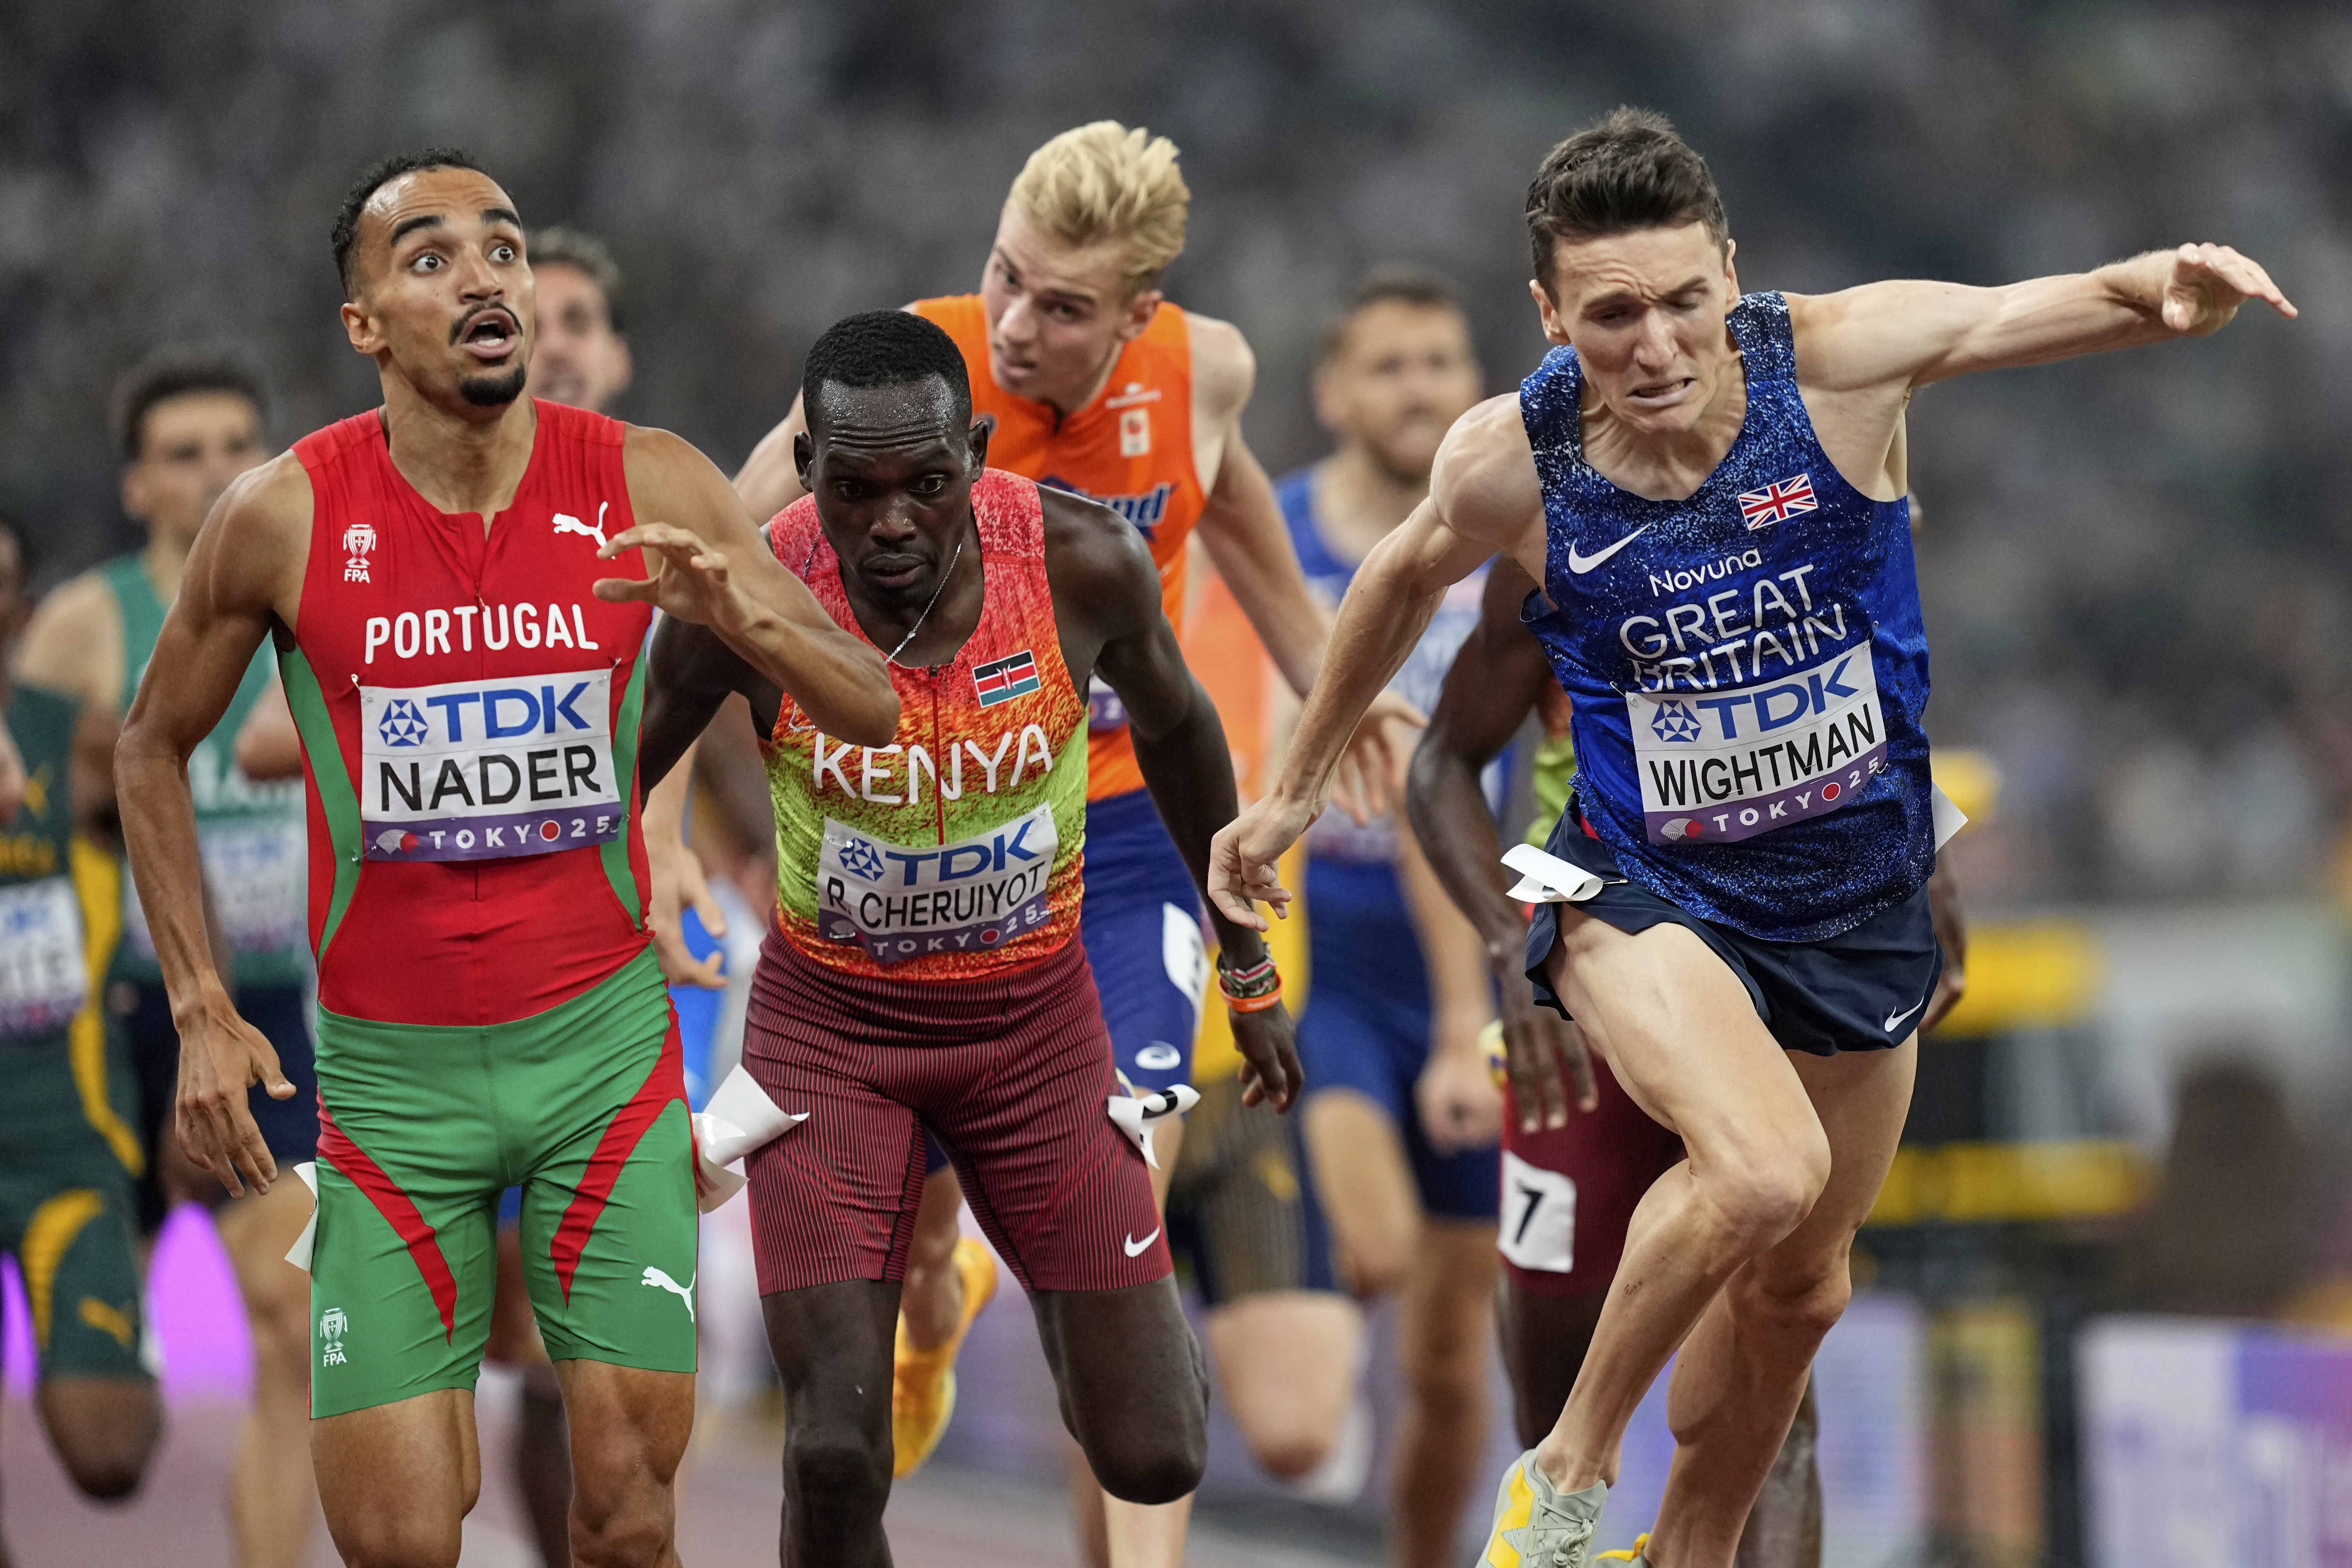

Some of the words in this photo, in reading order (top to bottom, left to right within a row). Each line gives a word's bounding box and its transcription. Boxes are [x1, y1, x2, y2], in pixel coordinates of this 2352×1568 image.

[344, 568, 370, 583] FPA
[1649, 548, 1762, 597] Novuna
[365, 603, 599, 664] PORTUGAL
[1619, 564, 1814, 658] GREAT
[1626, 603, 1847, 693] BRITAIN
[426, 682, 591, 743] TDK
[1697, 656, 1859, 740] TDK
[379, 745, 601, 811] NADER
[813, 724, 1052, 804] KENYA
[1649, 703, 1875, 806] WIGHTMAN
[885, 819, 1040, 886] TDK
[827, 876, 851, 915] R.
[860, 861, 1046, 928] CHERUIYOT
[1515, 1180, 1545, 1246] 7
[323, 1352, 347, 1367] FPA
